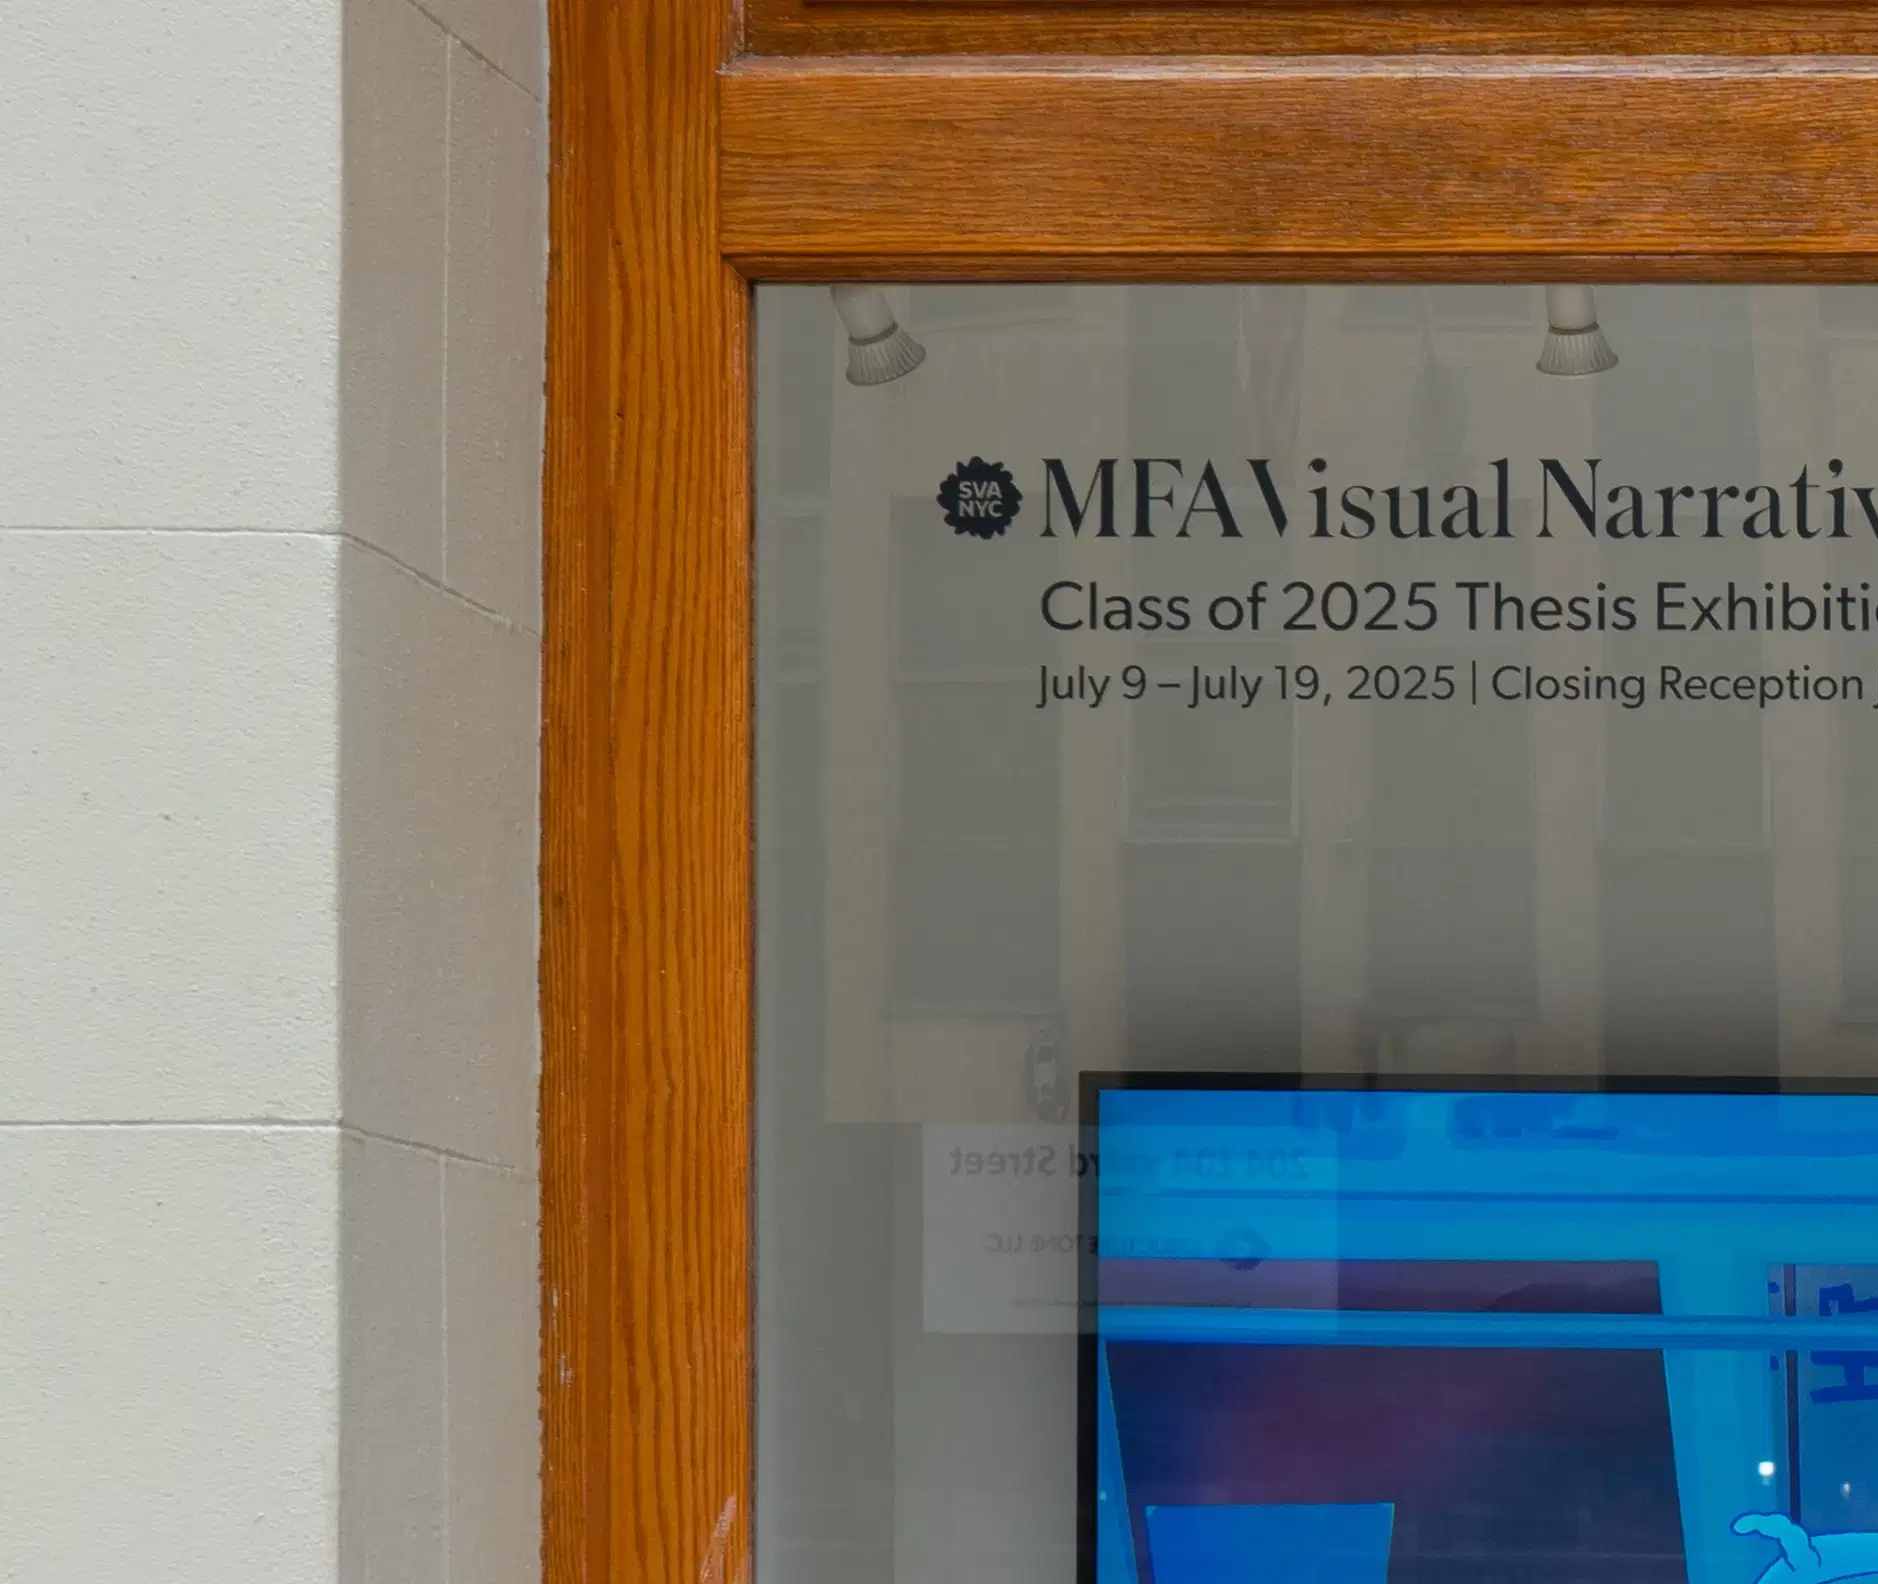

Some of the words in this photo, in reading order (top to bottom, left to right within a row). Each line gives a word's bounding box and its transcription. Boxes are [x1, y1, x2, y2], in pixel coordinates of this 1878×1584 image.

[958, 480, 1003, 499] SVA
[958, 500, 1004, 518] NYC
[1040, 458, 1243, 539] MFA
[1247, 458, 1517, 540] Visual
[1040, 580, 1192, 632] Class
[1208, 580, 1269, 631] of
[1282, 581, 1439, 632] 2025
[1455, 581, 1638, 632] Thesis
[1036, 664, 1111, 709] July
[1122, 665, 1147, 700] 9
[1188, 664, 1262, 709] July
[1275, 664, 1332, 707] 19,
[1346, 664, 1456, 701] 2025
[1491, 664, 1646, 710] Closing
[1659, 664, 1864, 710] Reception
